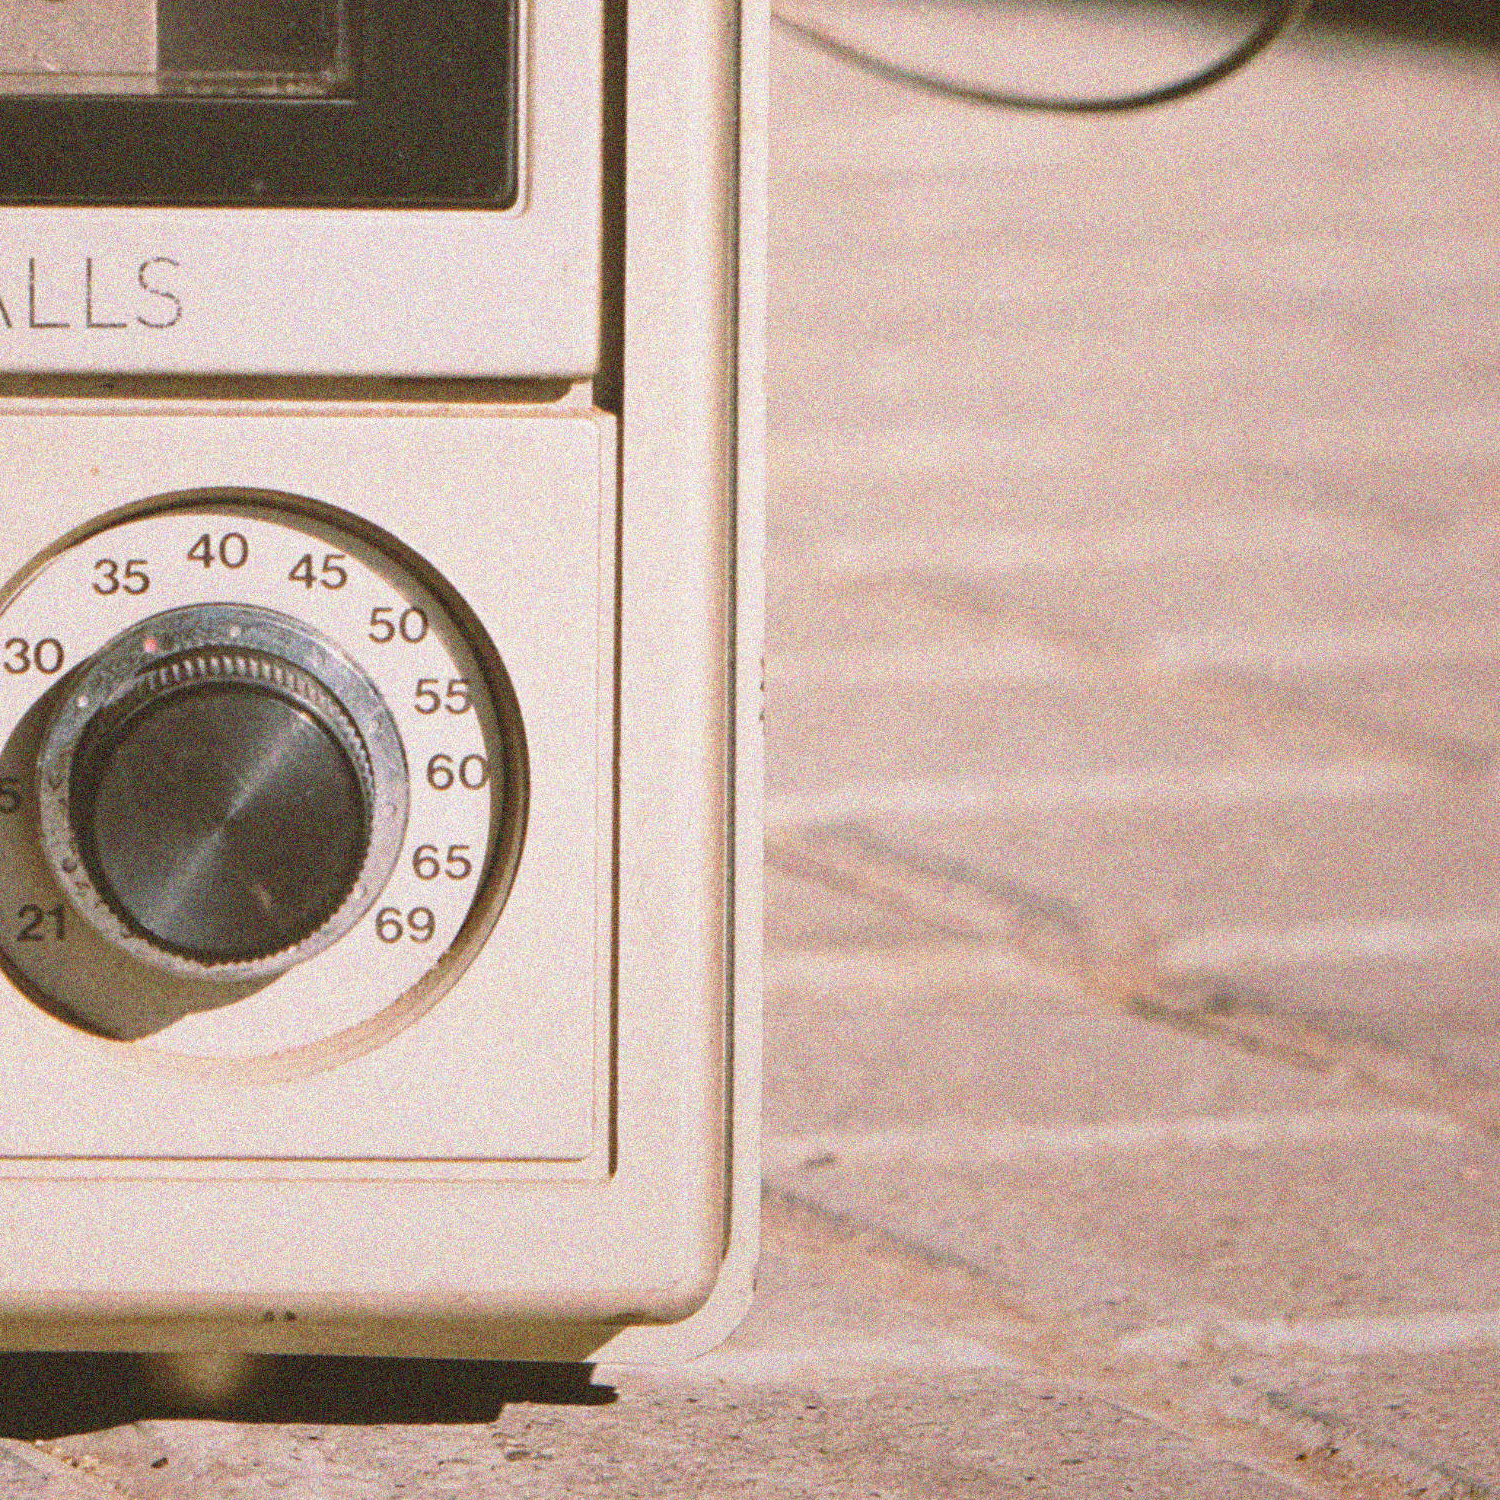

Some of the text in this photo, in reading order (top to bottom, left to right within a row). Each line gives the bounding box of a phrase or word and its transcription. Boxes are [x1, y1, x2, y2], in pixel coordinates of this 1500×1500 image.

[186, 532, 250, 570] 40
[92, 558, 151, 597] 35
[288, 552, 349, 591] 45
[368, 606, 430, 645] 50
[2, 636, 65, 675] 30
[413, 676, 472, 716] 55
[426, 752, 489, 793] 60
[411, 843, 473, 882] 65
[15, 902, 68, 942] 21
[374, 906, 436, 945] 69
